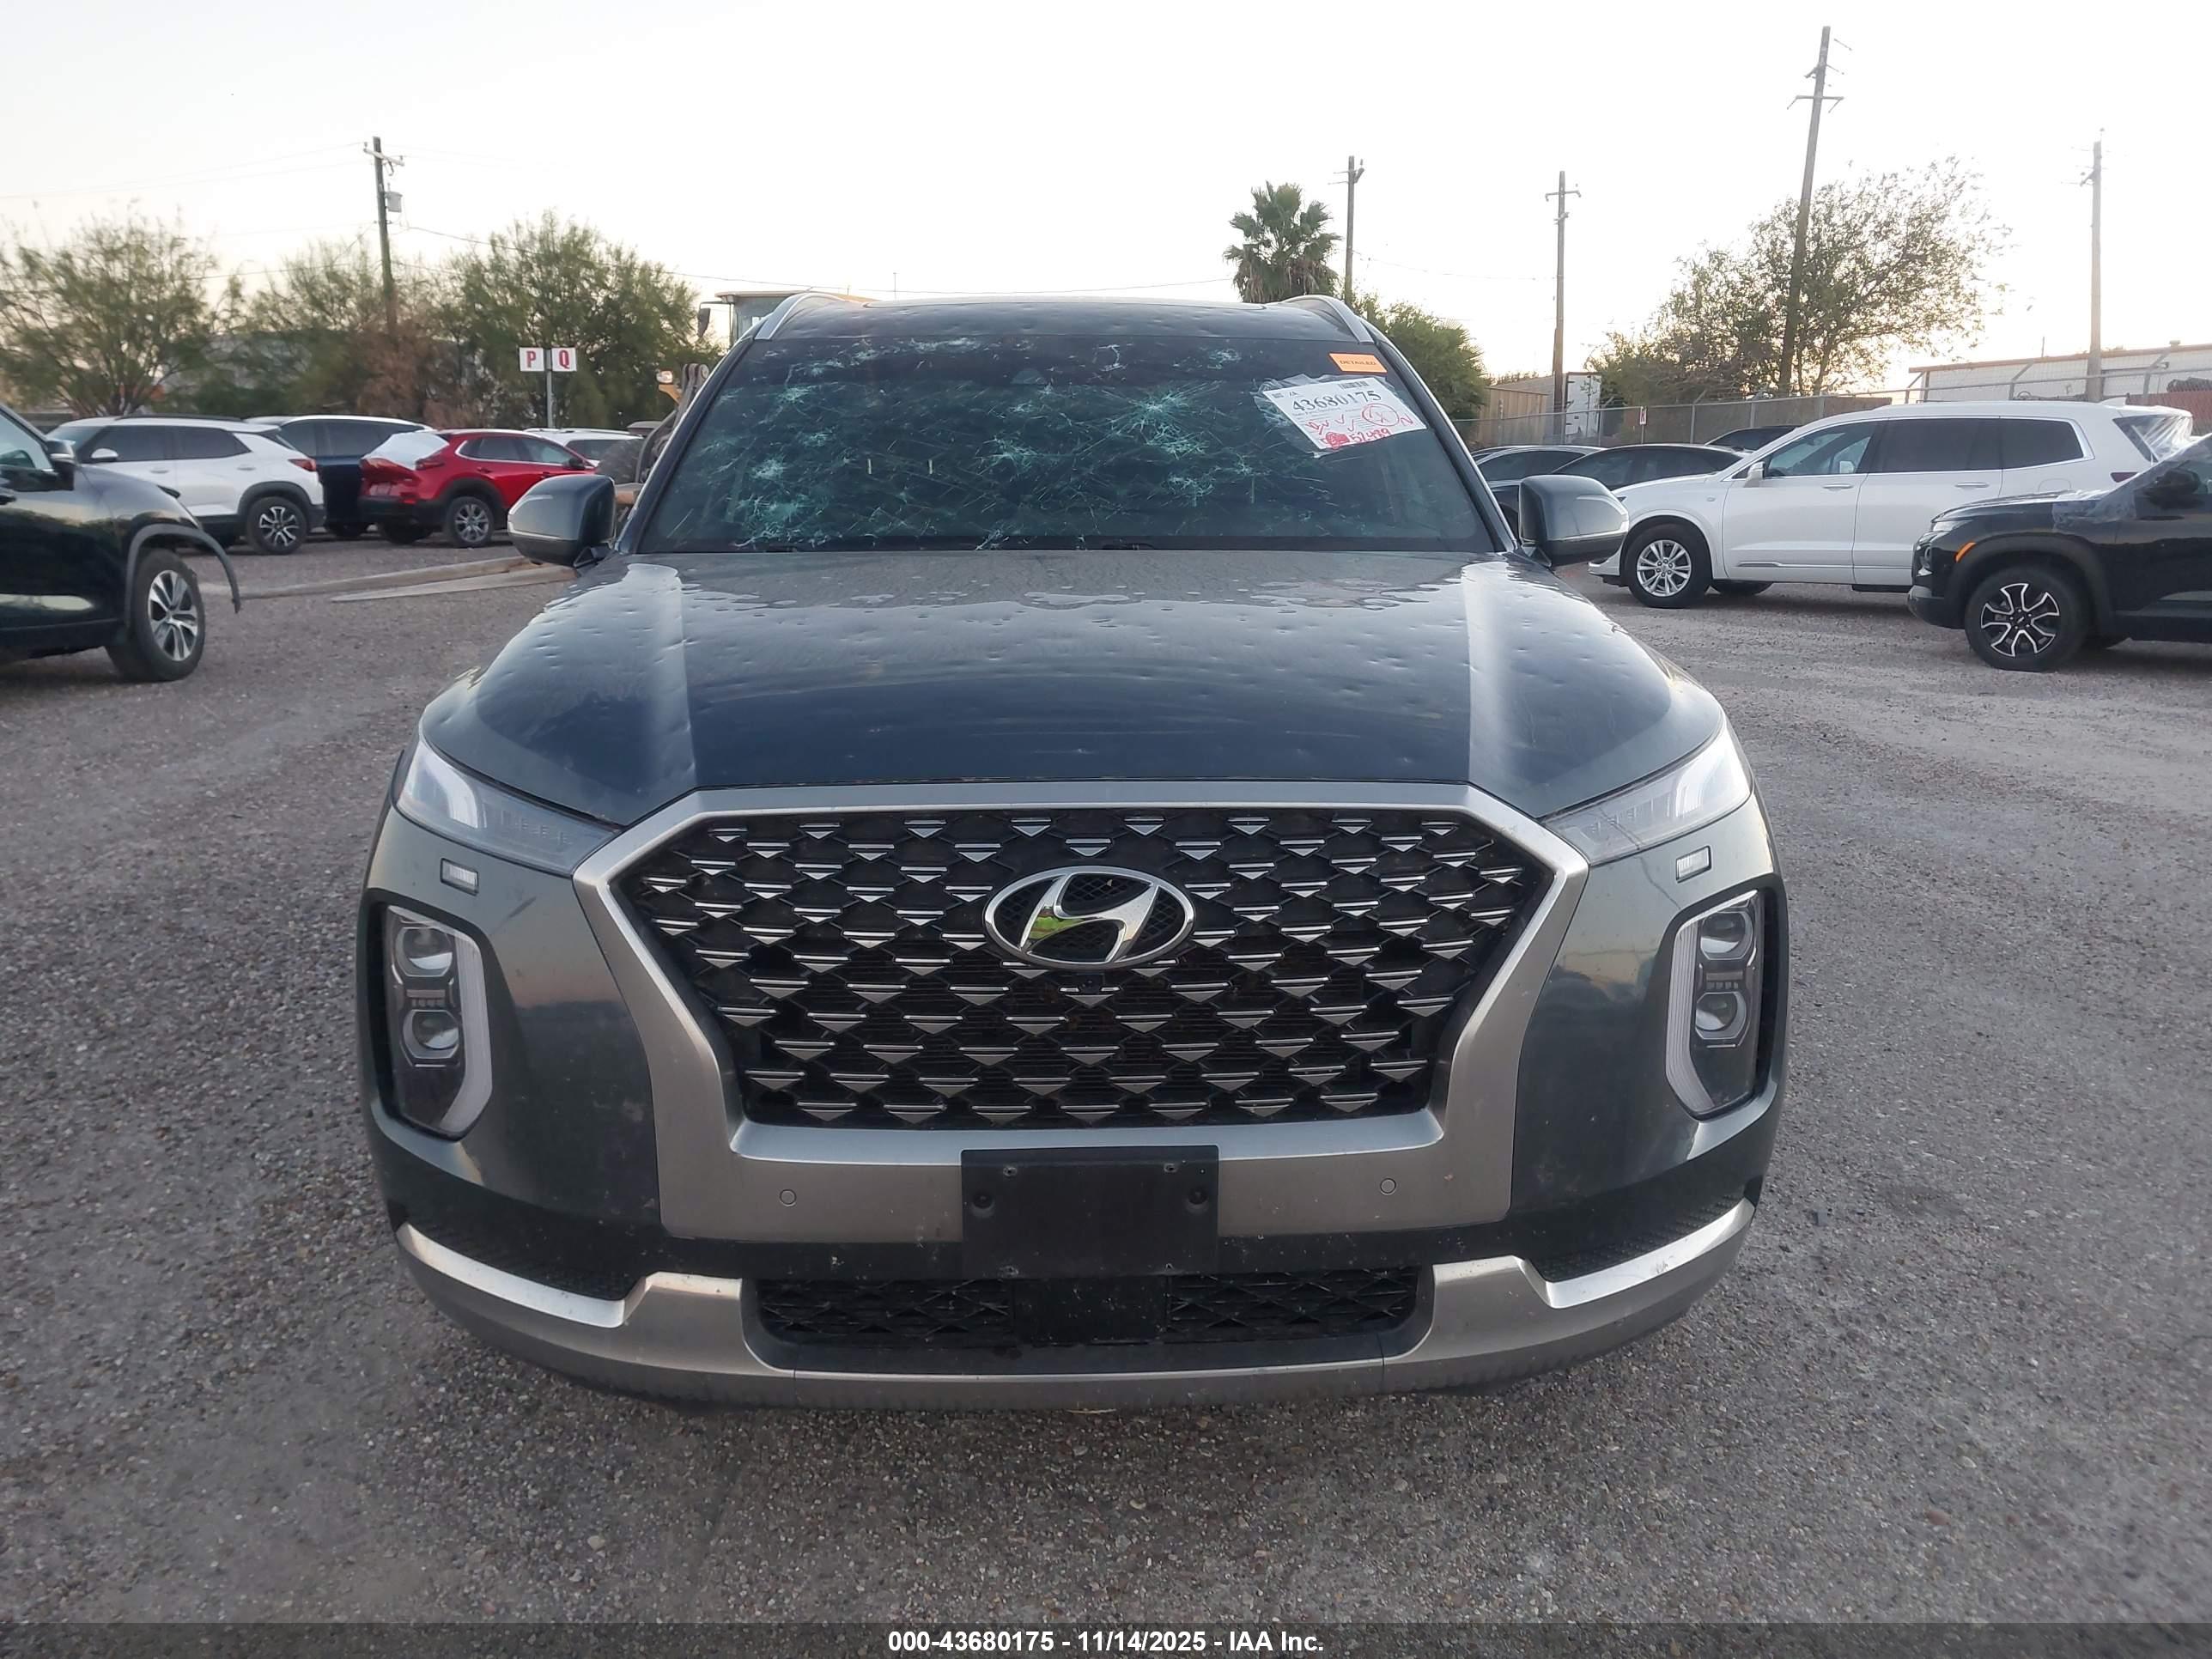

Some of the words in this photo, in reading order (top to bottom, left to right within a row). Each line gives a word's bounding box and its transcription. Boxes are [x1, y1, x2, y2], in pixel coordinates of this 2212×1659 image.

[526, 350, 537, 368] P
[558, 349, 570, 369] Q
[1292, 390, 1382, 411] 43680175
